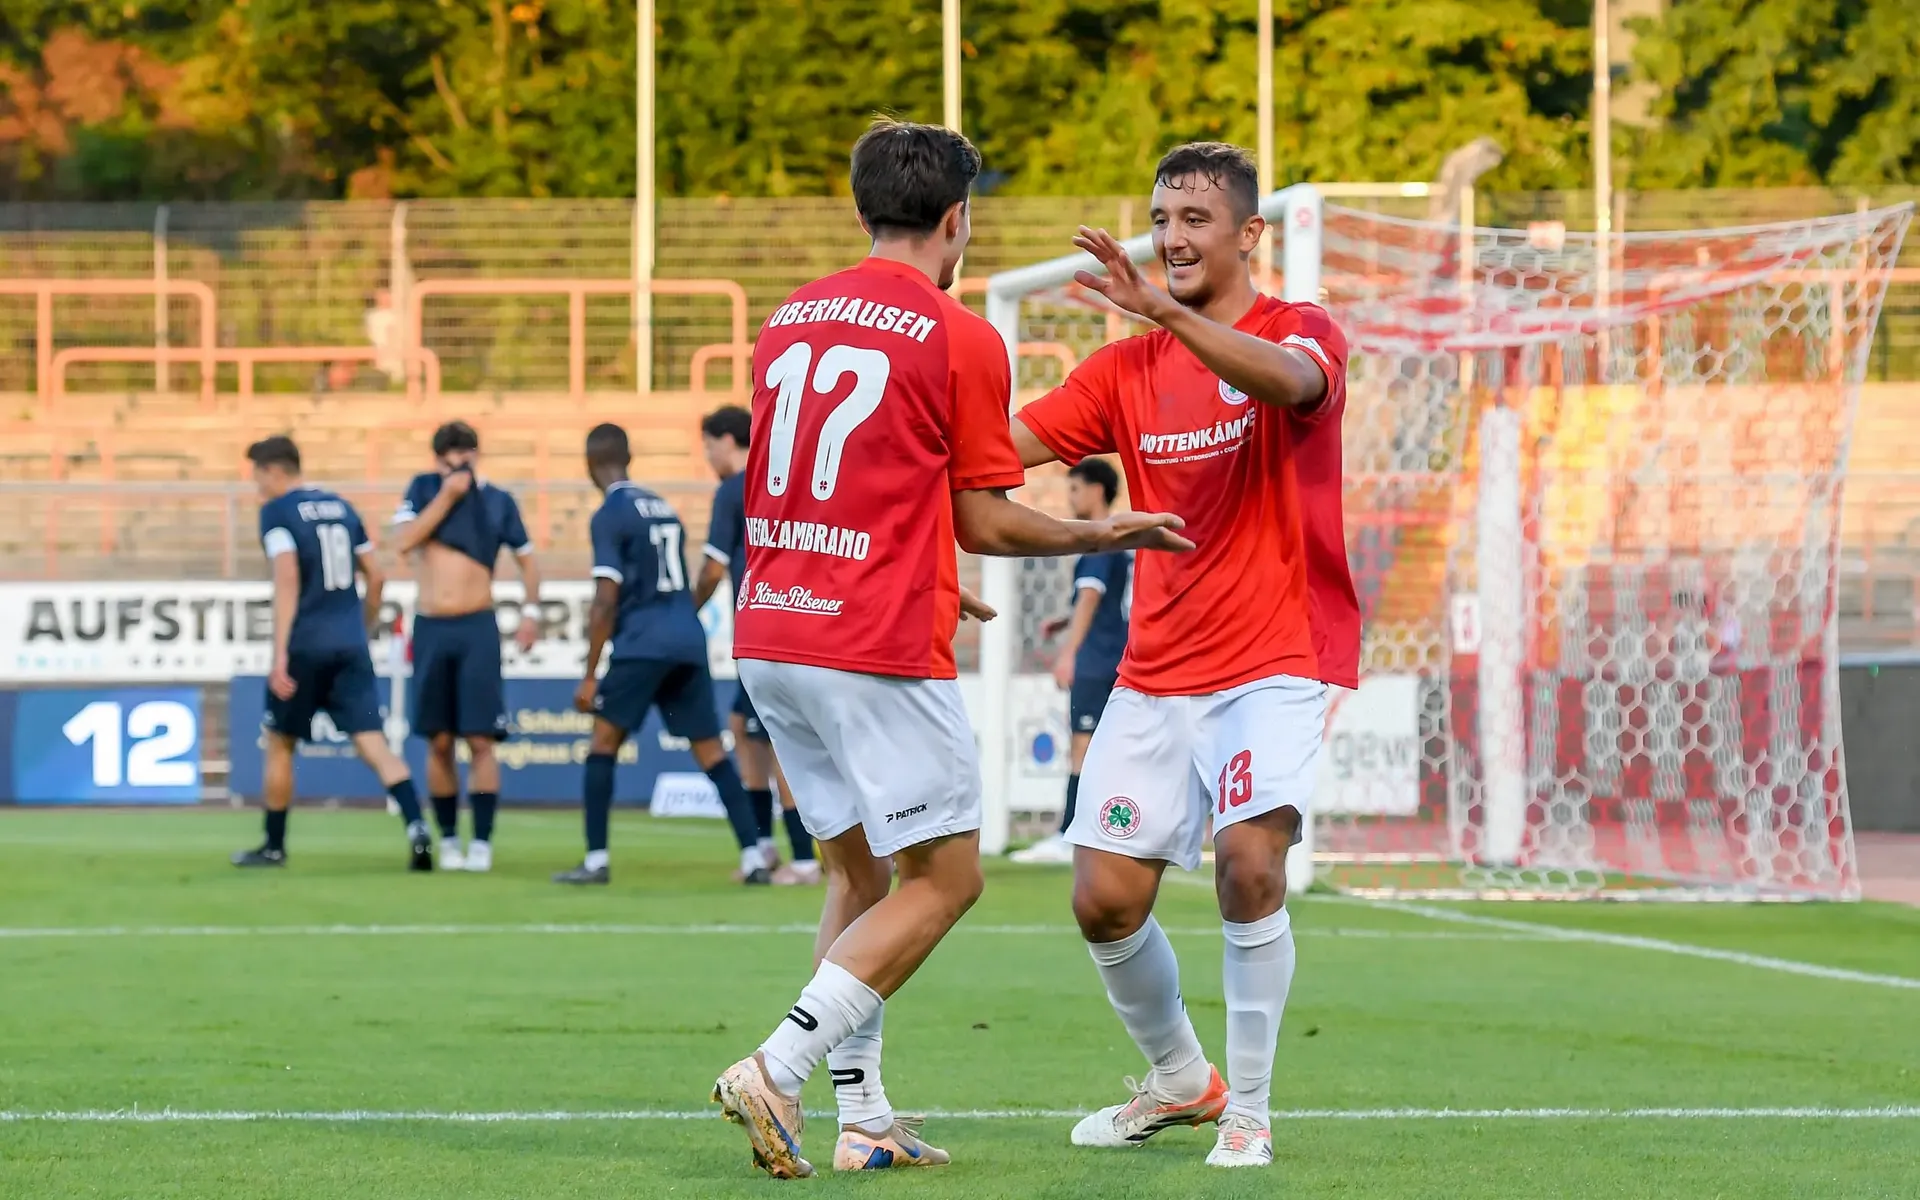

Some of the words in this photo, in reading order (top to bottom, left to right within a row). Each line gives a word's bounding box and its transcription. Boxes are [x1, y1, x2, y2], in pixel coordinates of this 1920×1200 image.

[768, 296, 938, 343] OBERHAUSEN
[765, 342, 890, 501] 17
[1138, 407, 1255, 453] NOTTENKÄMPE
[649, 523, 684, 592] 17
[24, 600, 274, 642] AUFSTIE
[62, 700, 197, 788] 12
[1218, 749, 1252, 814] 13
[895, 803, 928, 821] PATRICK
